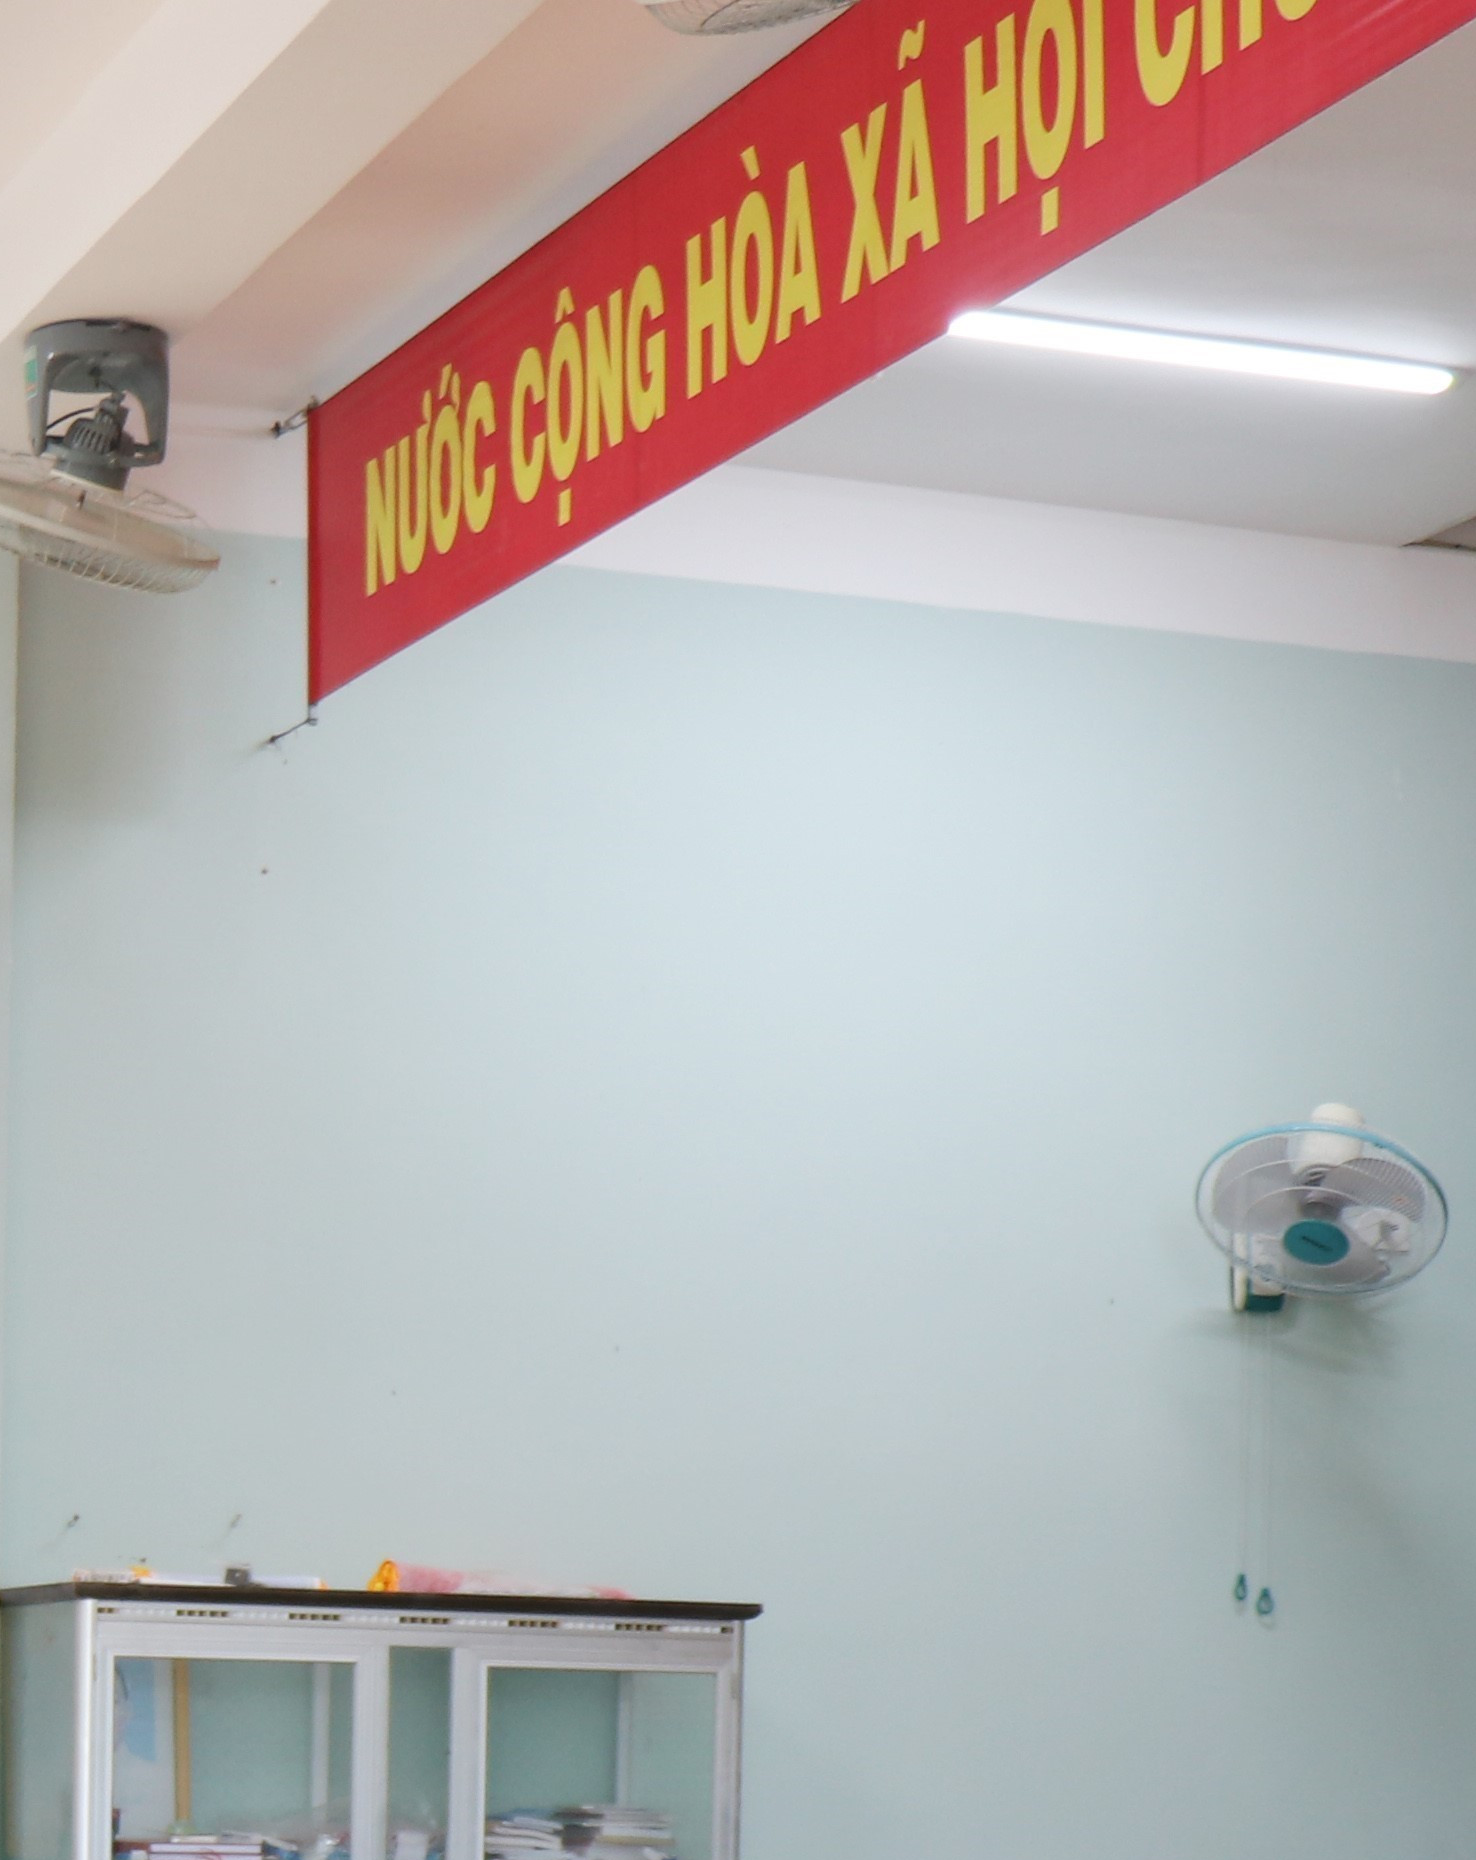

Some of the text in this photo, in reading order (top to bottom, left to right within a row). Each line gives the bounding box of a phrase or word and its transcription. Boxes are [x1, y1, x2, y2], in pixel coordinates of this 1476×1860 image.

[365, 363, 496, 597] NƯỚC
[510, 264, 666, 526] CỘNG
[685, 146, 822, 399] HÒA
[840, 20, 941, 303] XÃ
